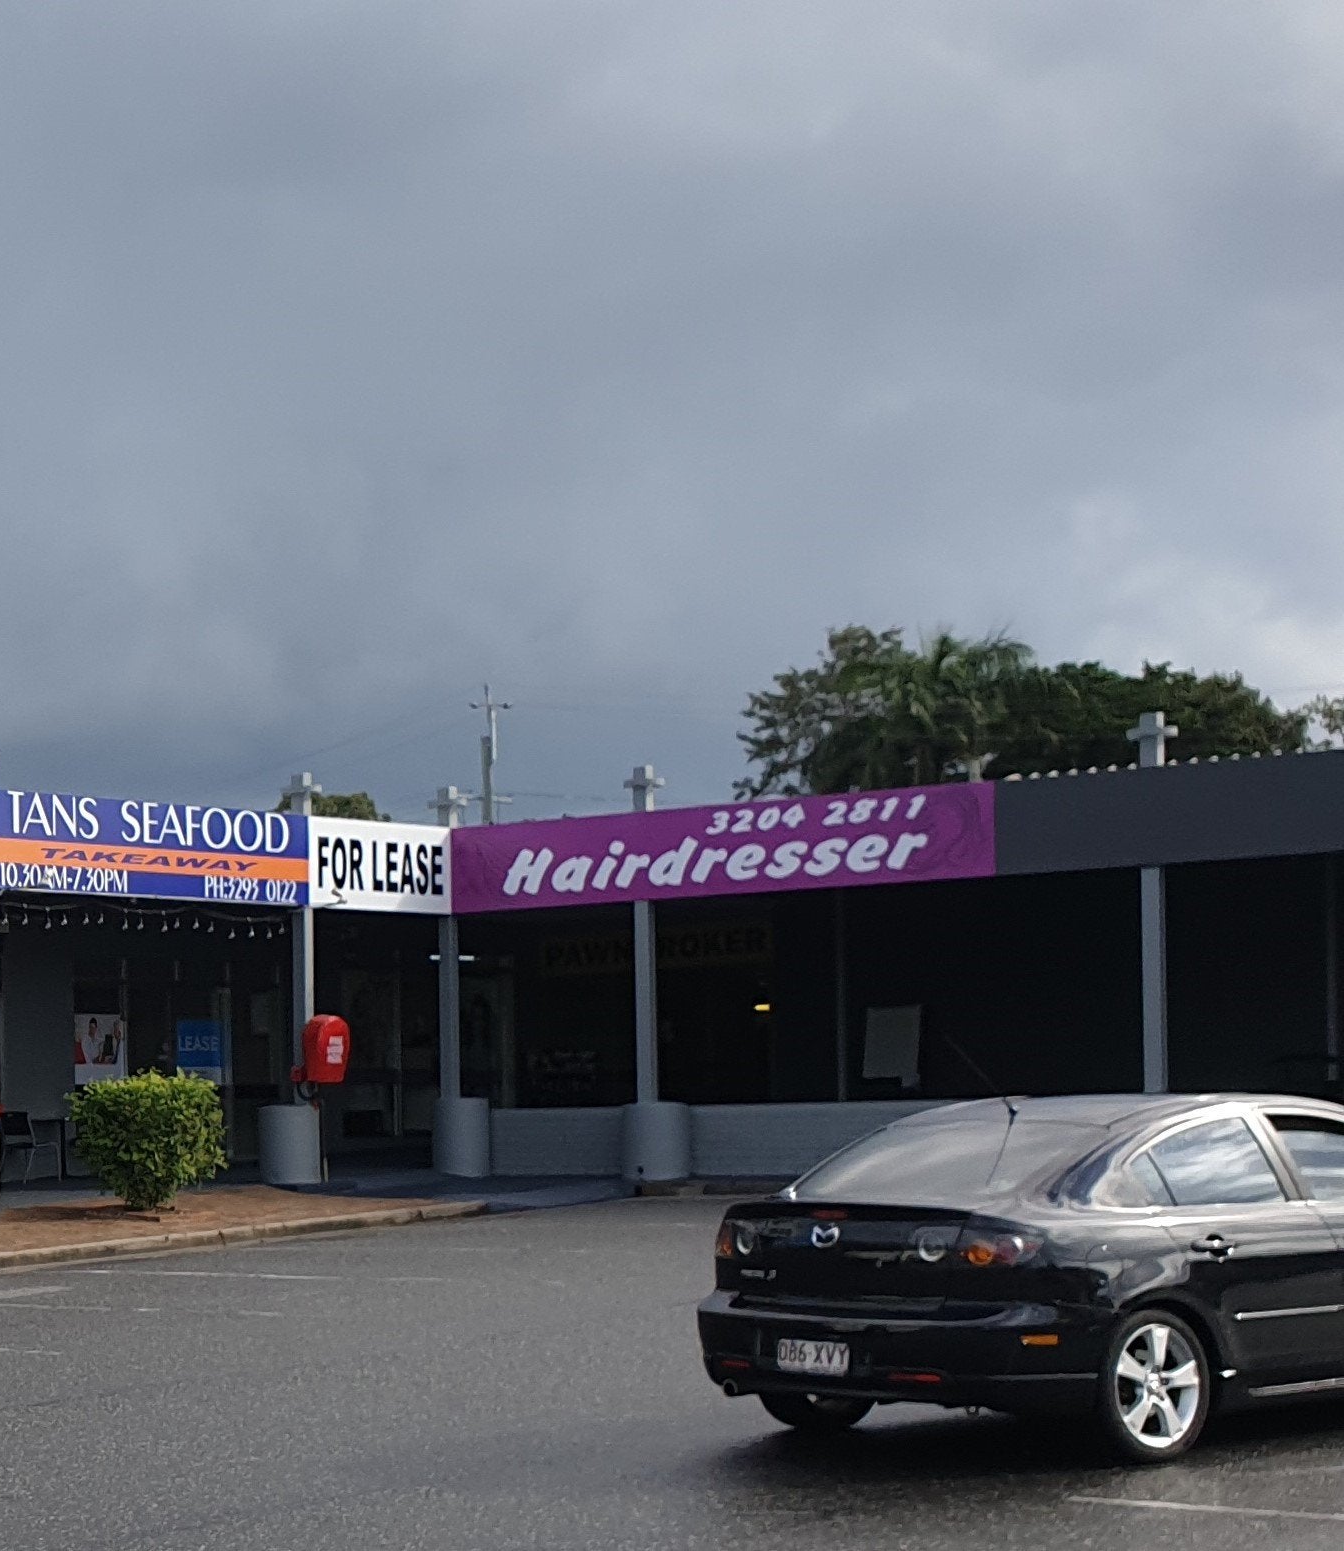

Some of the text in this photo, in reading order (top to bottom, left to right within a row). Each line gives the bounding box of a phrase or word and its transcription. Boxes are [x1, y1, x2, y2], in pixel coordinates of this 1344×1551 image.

[7, 790, 290, 853] TANS SEAFOOD
[706, 794, 927, 836] 3204 2811
[40, 848, 258, 872] TAKEAWAY
[316, 837, 444, 896] FOR LEASE
[502, 832, 928, 896] Hairdresser
[265, 880, 297, 902] 0122
[545, 927, 766, 966] PAWNROKER
